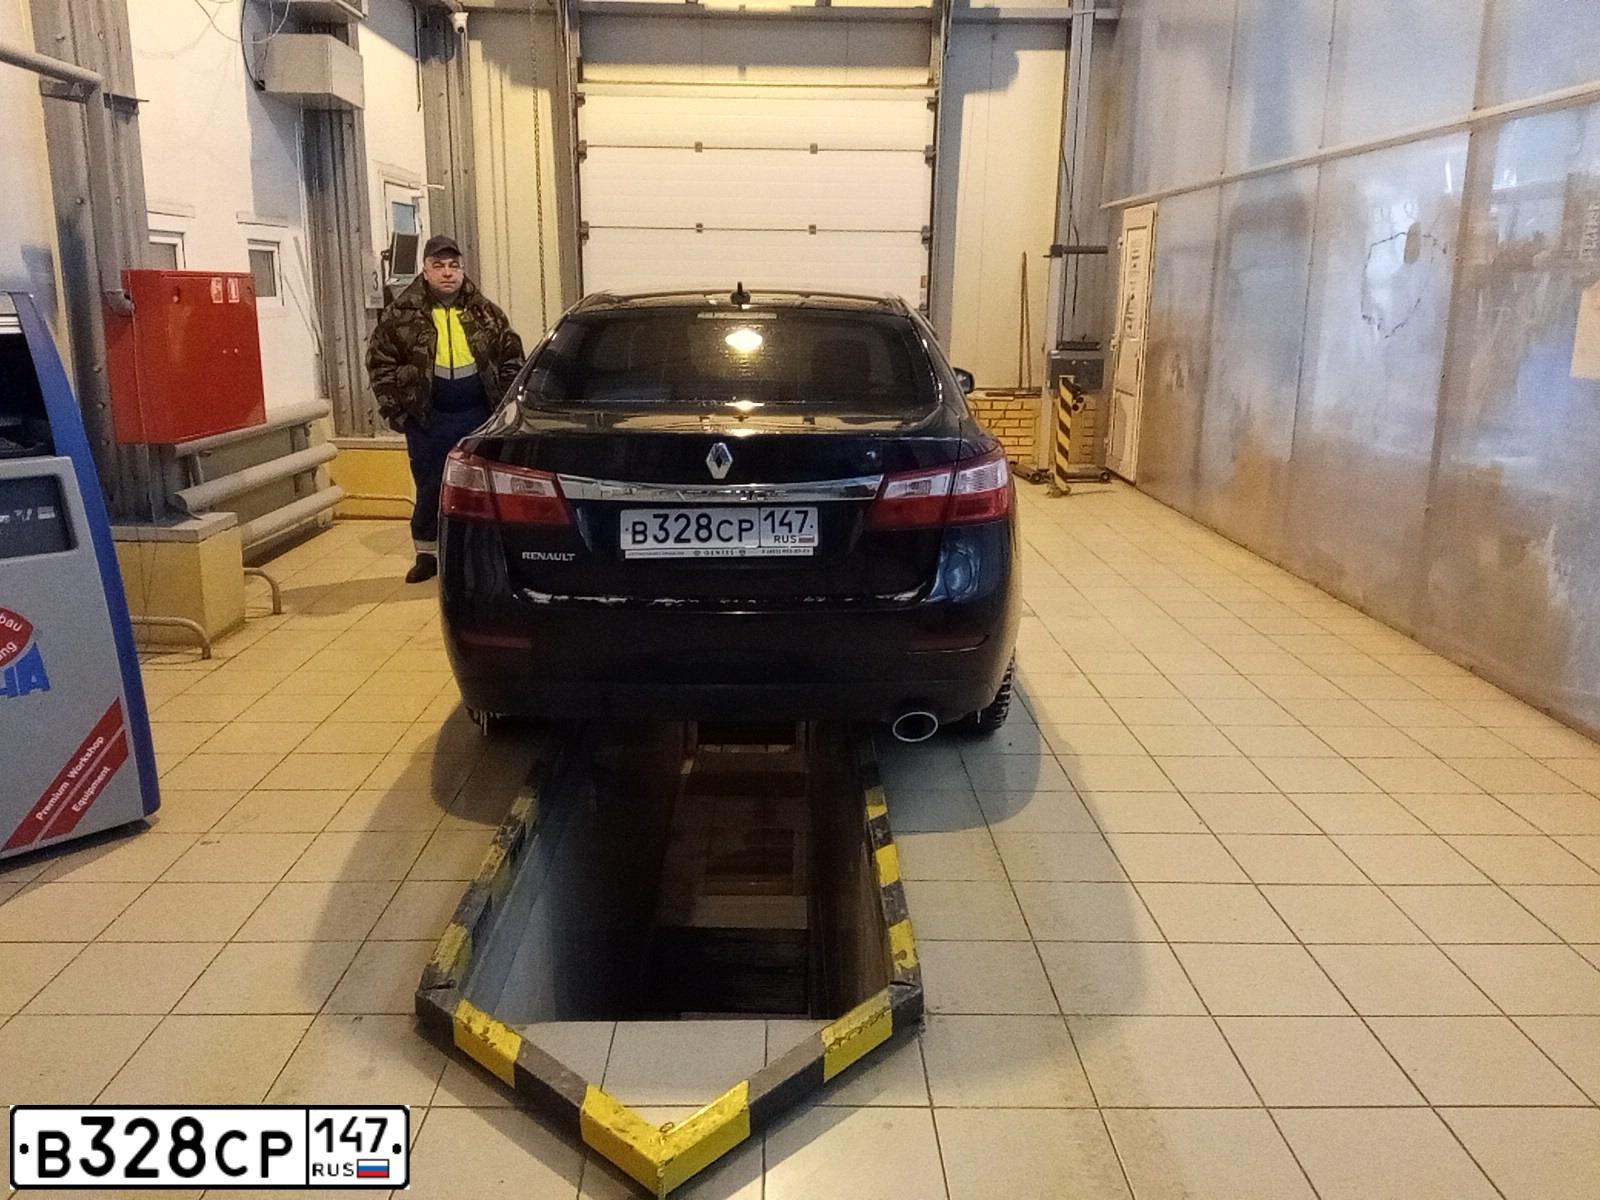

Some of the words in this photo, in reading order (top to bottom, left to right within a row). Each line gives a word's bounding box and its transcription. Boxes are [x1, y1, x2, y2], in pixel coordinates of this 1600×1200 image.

[763, 509, 810, 534] 147
[773, 534, 797, 544] RUS
[522, 551, 576, 562] RENAULT
[35, 781, 70, 821] Premium
[67, 735, 105, 779] Workshop
[71, 765, 111, 813] Equipment
